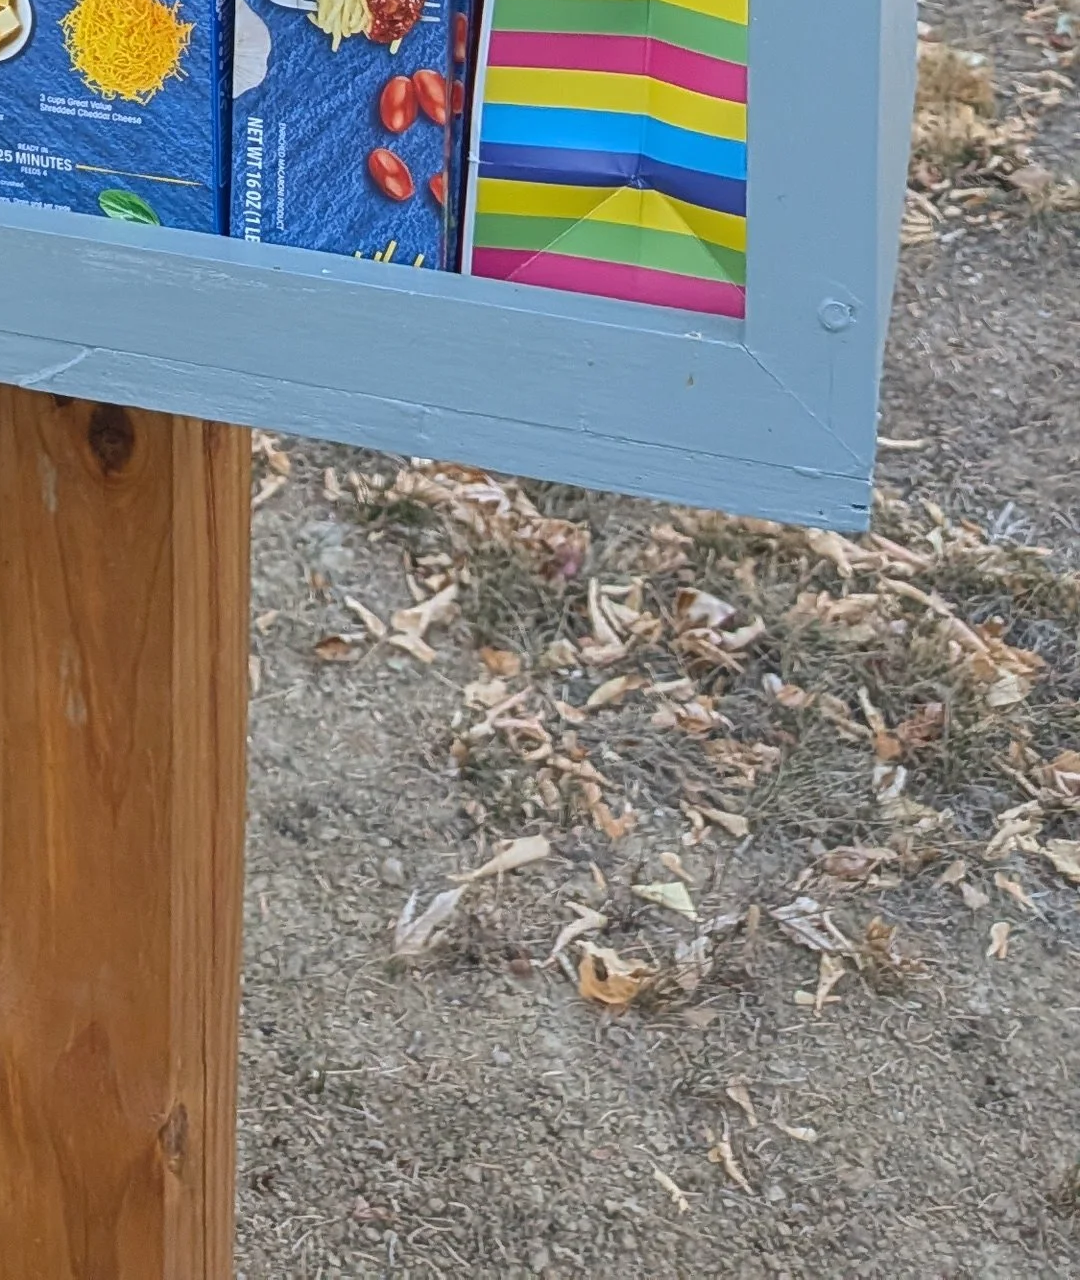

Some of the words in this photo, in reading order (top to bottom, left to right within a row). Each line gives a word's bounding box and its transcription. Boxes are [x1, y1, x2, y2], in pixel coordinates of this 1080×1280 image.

[40, 103, 77, 116] Shredded
[77, 108, 111, 121] Cheddar
[112, 112, 142, 125] Cheese
[47, 95, 66, 106] cups
[67, 97, 89, 109] Great
[90, 100, 112, 112] Value
[247, 116, 264, 145] NET
[15, 150, 73, 173] MINUTES
[246, 147, 263, 170] WT
[246, 172, 262, 189] 16
[245, 190, 262, 210] OZ
[243, 210, 262, 225] (1
